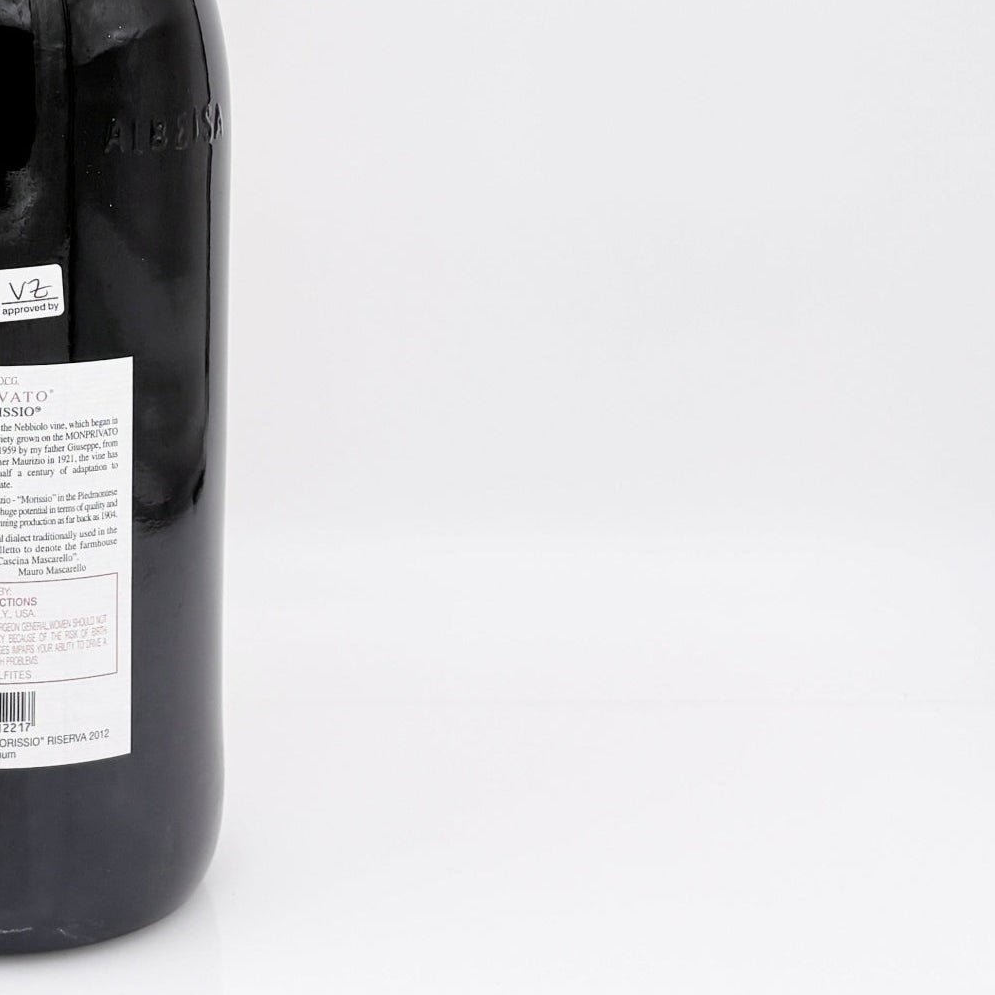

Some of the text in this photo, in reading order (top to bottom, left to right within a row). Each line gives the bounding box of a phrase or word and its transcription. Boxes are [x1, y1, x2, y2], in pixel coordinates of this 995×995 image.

[2, 302, 60, 316] approved by
[0, 423, 12, 431] the
[14, 422, 48, 430] Nebbiolo
[68, 419, 89, 428] which
[91, 417, 110, 428] began
[16, 436, 39, 444] grown
[65, 427, 118, 440] MONPRIVATO
[18, 446, 27, 455] by
[30, 447, 41, 455] my
[44, 444, 64, 452] father
[67, 441, 100, 453] Giuseppe,
[102, 439, 118, 447] from
[12, 457, 45, 465] Maurizio
[92, 452, 105, 460] vine
[108, 450, 118, 458] has
[27, 468, 54, 478] century
[72, 463, 107, 475] adaptation
[18, 564, 86, 576] Mauro Mascarello
[47, 732, 87, 746] RISERVA
[88, 728, 110, 741] 2012
